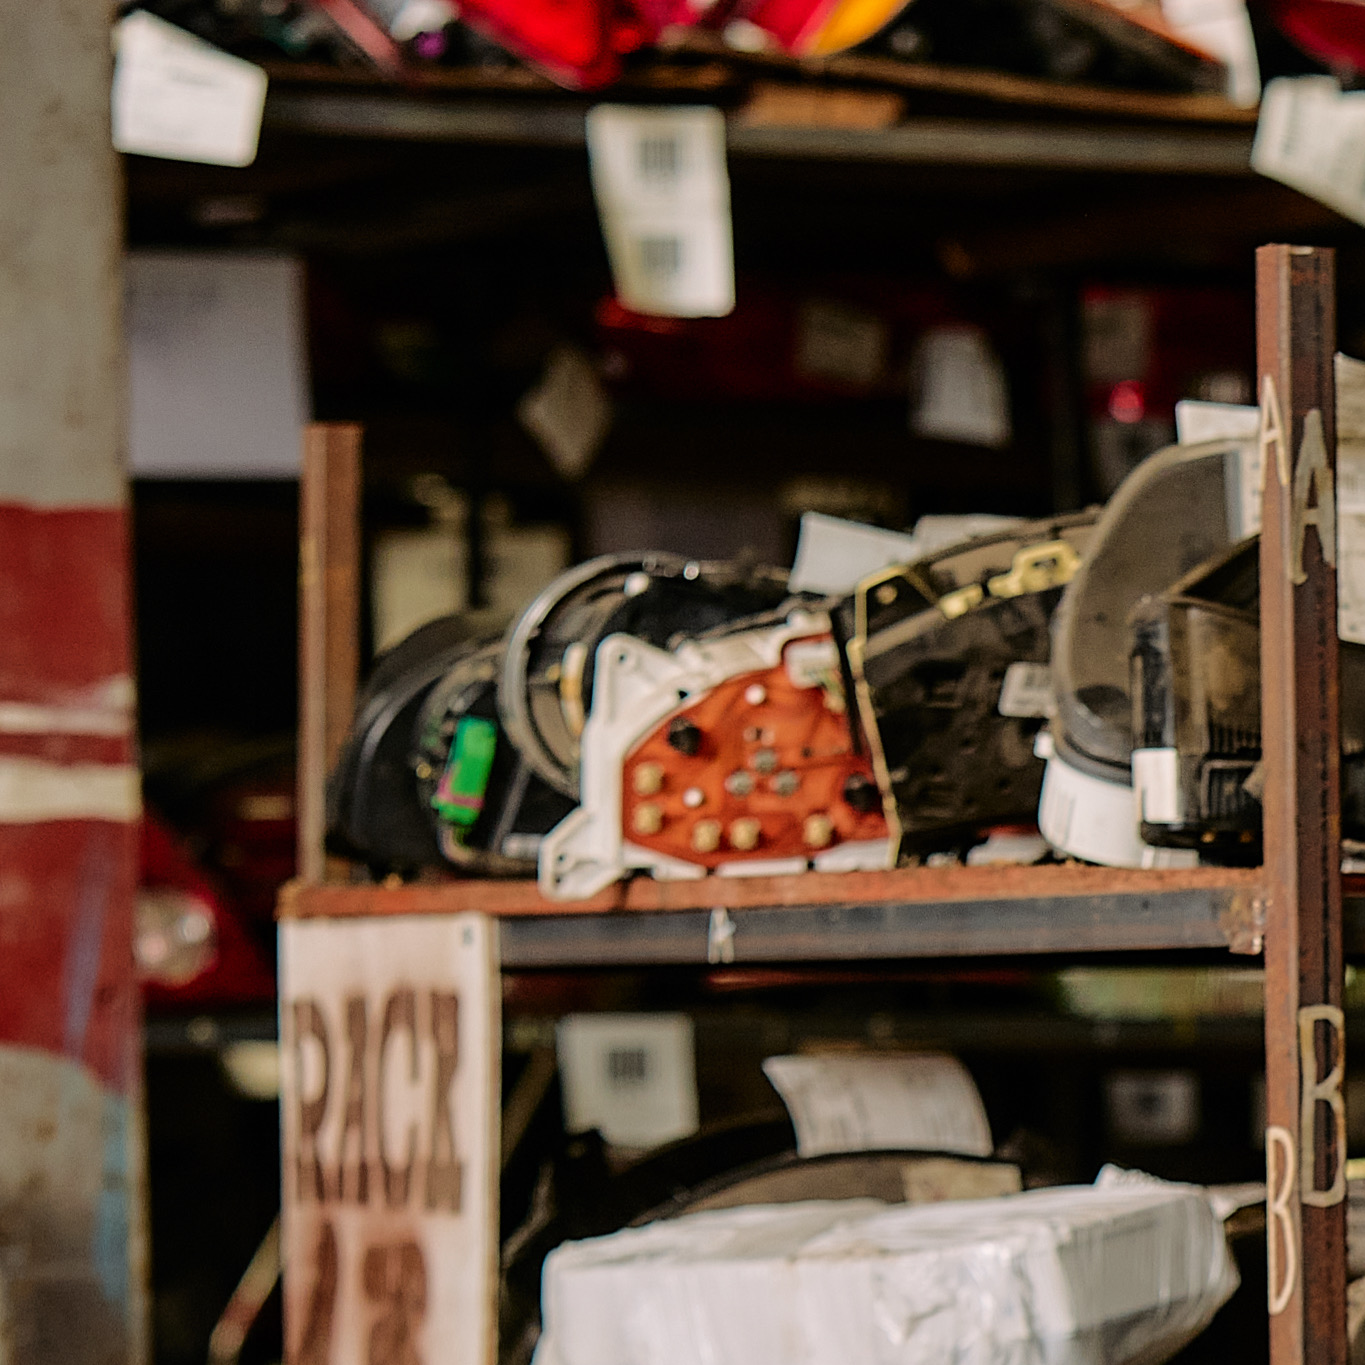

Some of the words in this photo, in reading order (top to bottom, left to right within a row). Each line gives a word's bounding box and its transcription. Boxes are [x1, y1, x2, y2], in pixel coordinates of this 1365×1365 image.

[1292, 408, 1337, 585] A
[1299, 1005, 1347, 1207] B
[1267, 1126, 1297, 1316] B
